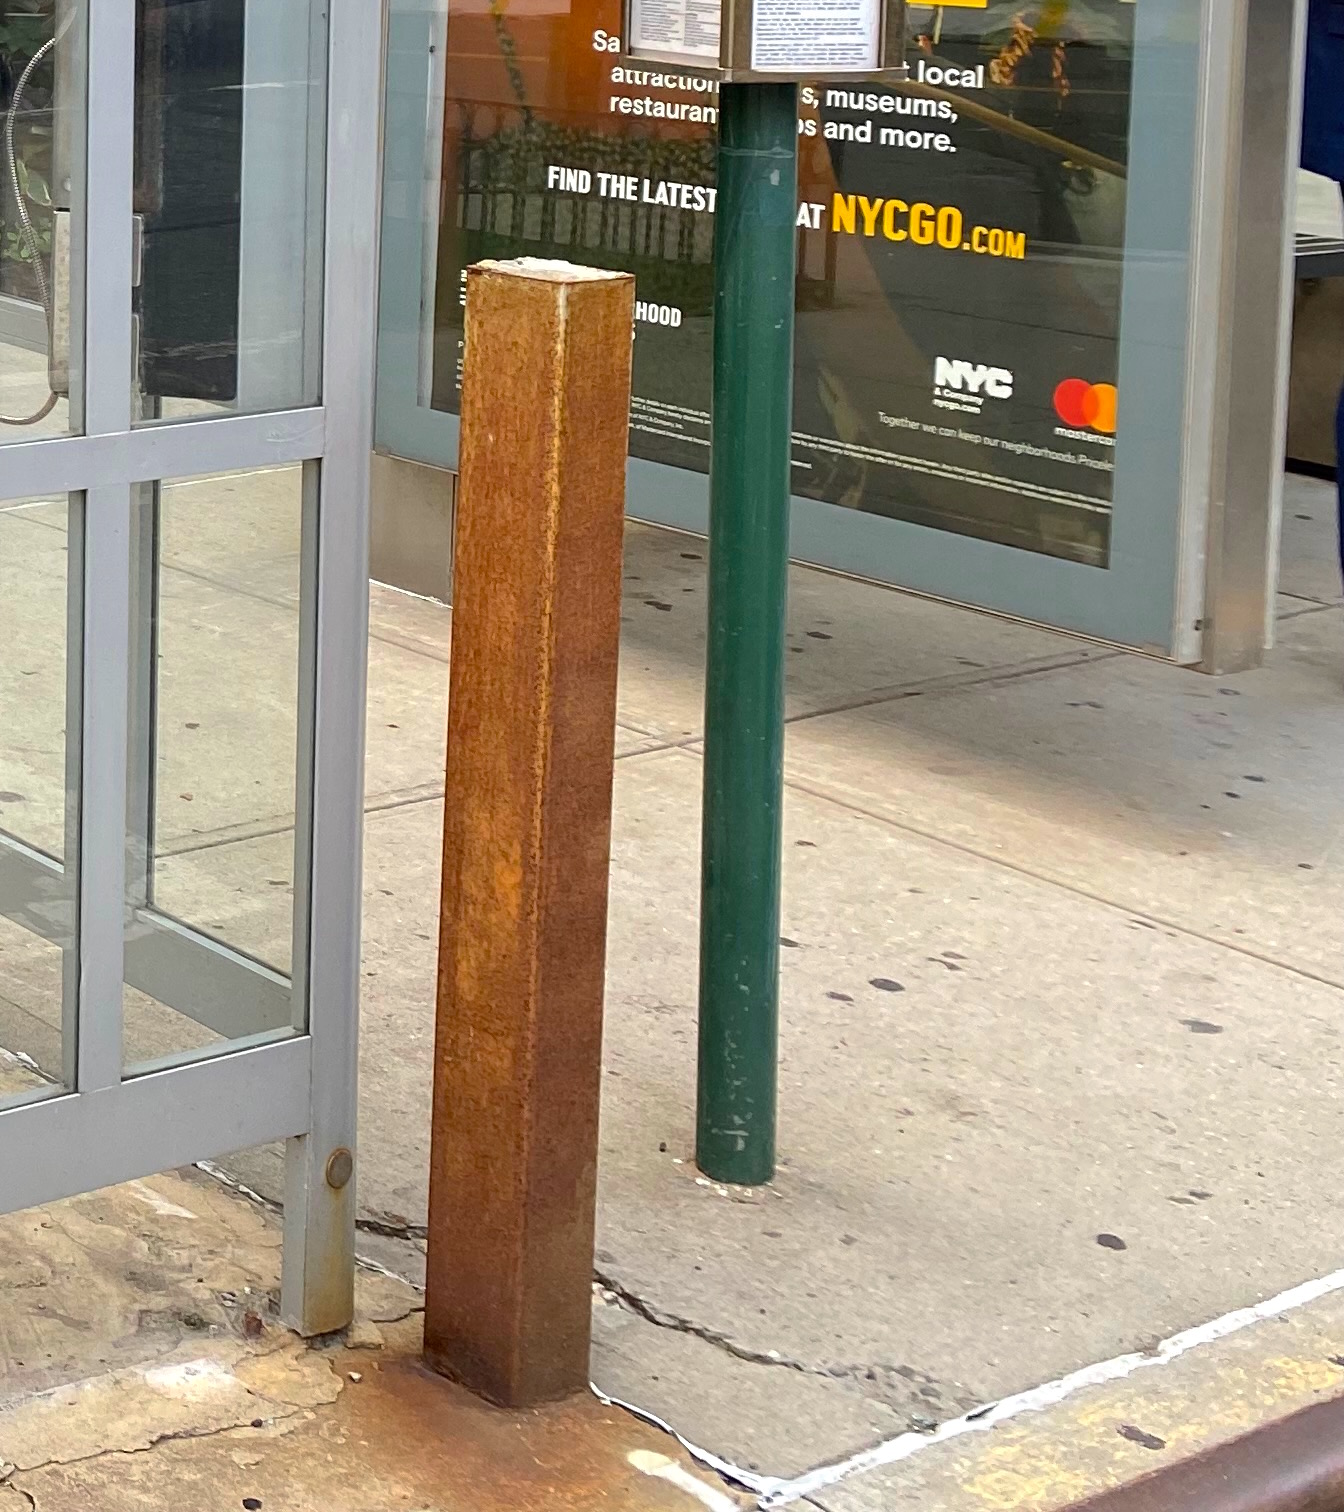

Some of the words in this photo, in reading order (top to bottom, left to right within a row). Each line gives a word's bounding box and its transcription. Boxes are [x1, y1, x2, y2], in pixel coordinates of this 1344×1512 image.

[611, 65, 719, 94] attraction
[825, 87, 959, 124] museums,
[918, 59, 985, 89] local
[610, 95, 719, 124] restauran
[823, 121, 872, 144] and
[879, 128, 957, 153] more.
[547, 165, 591, 195] FIND
[597, 172, 639, 201] THE
[642, 175, 718, 213] LATEST
[796, 202, 827, 231] AT
[832, 192, 1027, 261] NYCGO.COM
[934, 356, 1014, 400] NYC
[878, 411, 921, 431] Together
